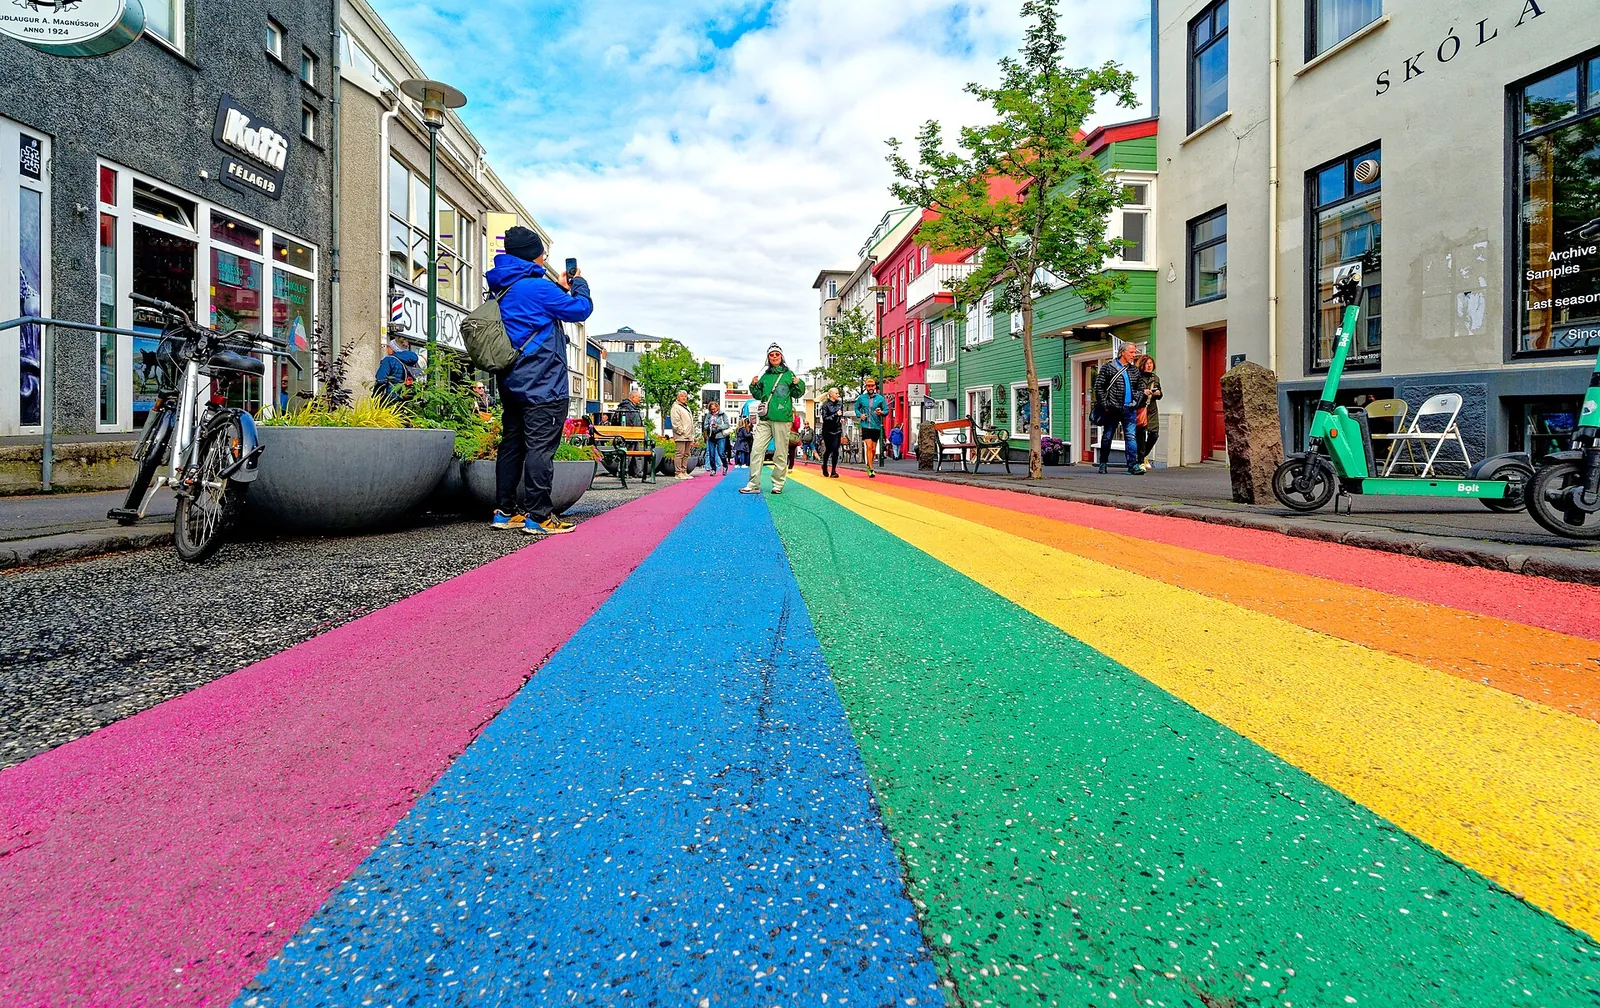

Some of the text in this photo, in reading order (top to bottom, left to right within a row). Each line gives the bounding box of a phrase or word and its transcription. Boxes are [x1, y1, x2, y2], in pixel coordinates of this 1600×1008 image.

[53, 19, 99, 28] MAGNÚSSON
[1548, 245, 1597, 262] Archive
[1526, 264, 1580, 281] Samples
[1526, 299, 1553, 311] Last
[1338, 332, 1350, 347] Bolt
[1457, 483, 1480, 494] Bolt
